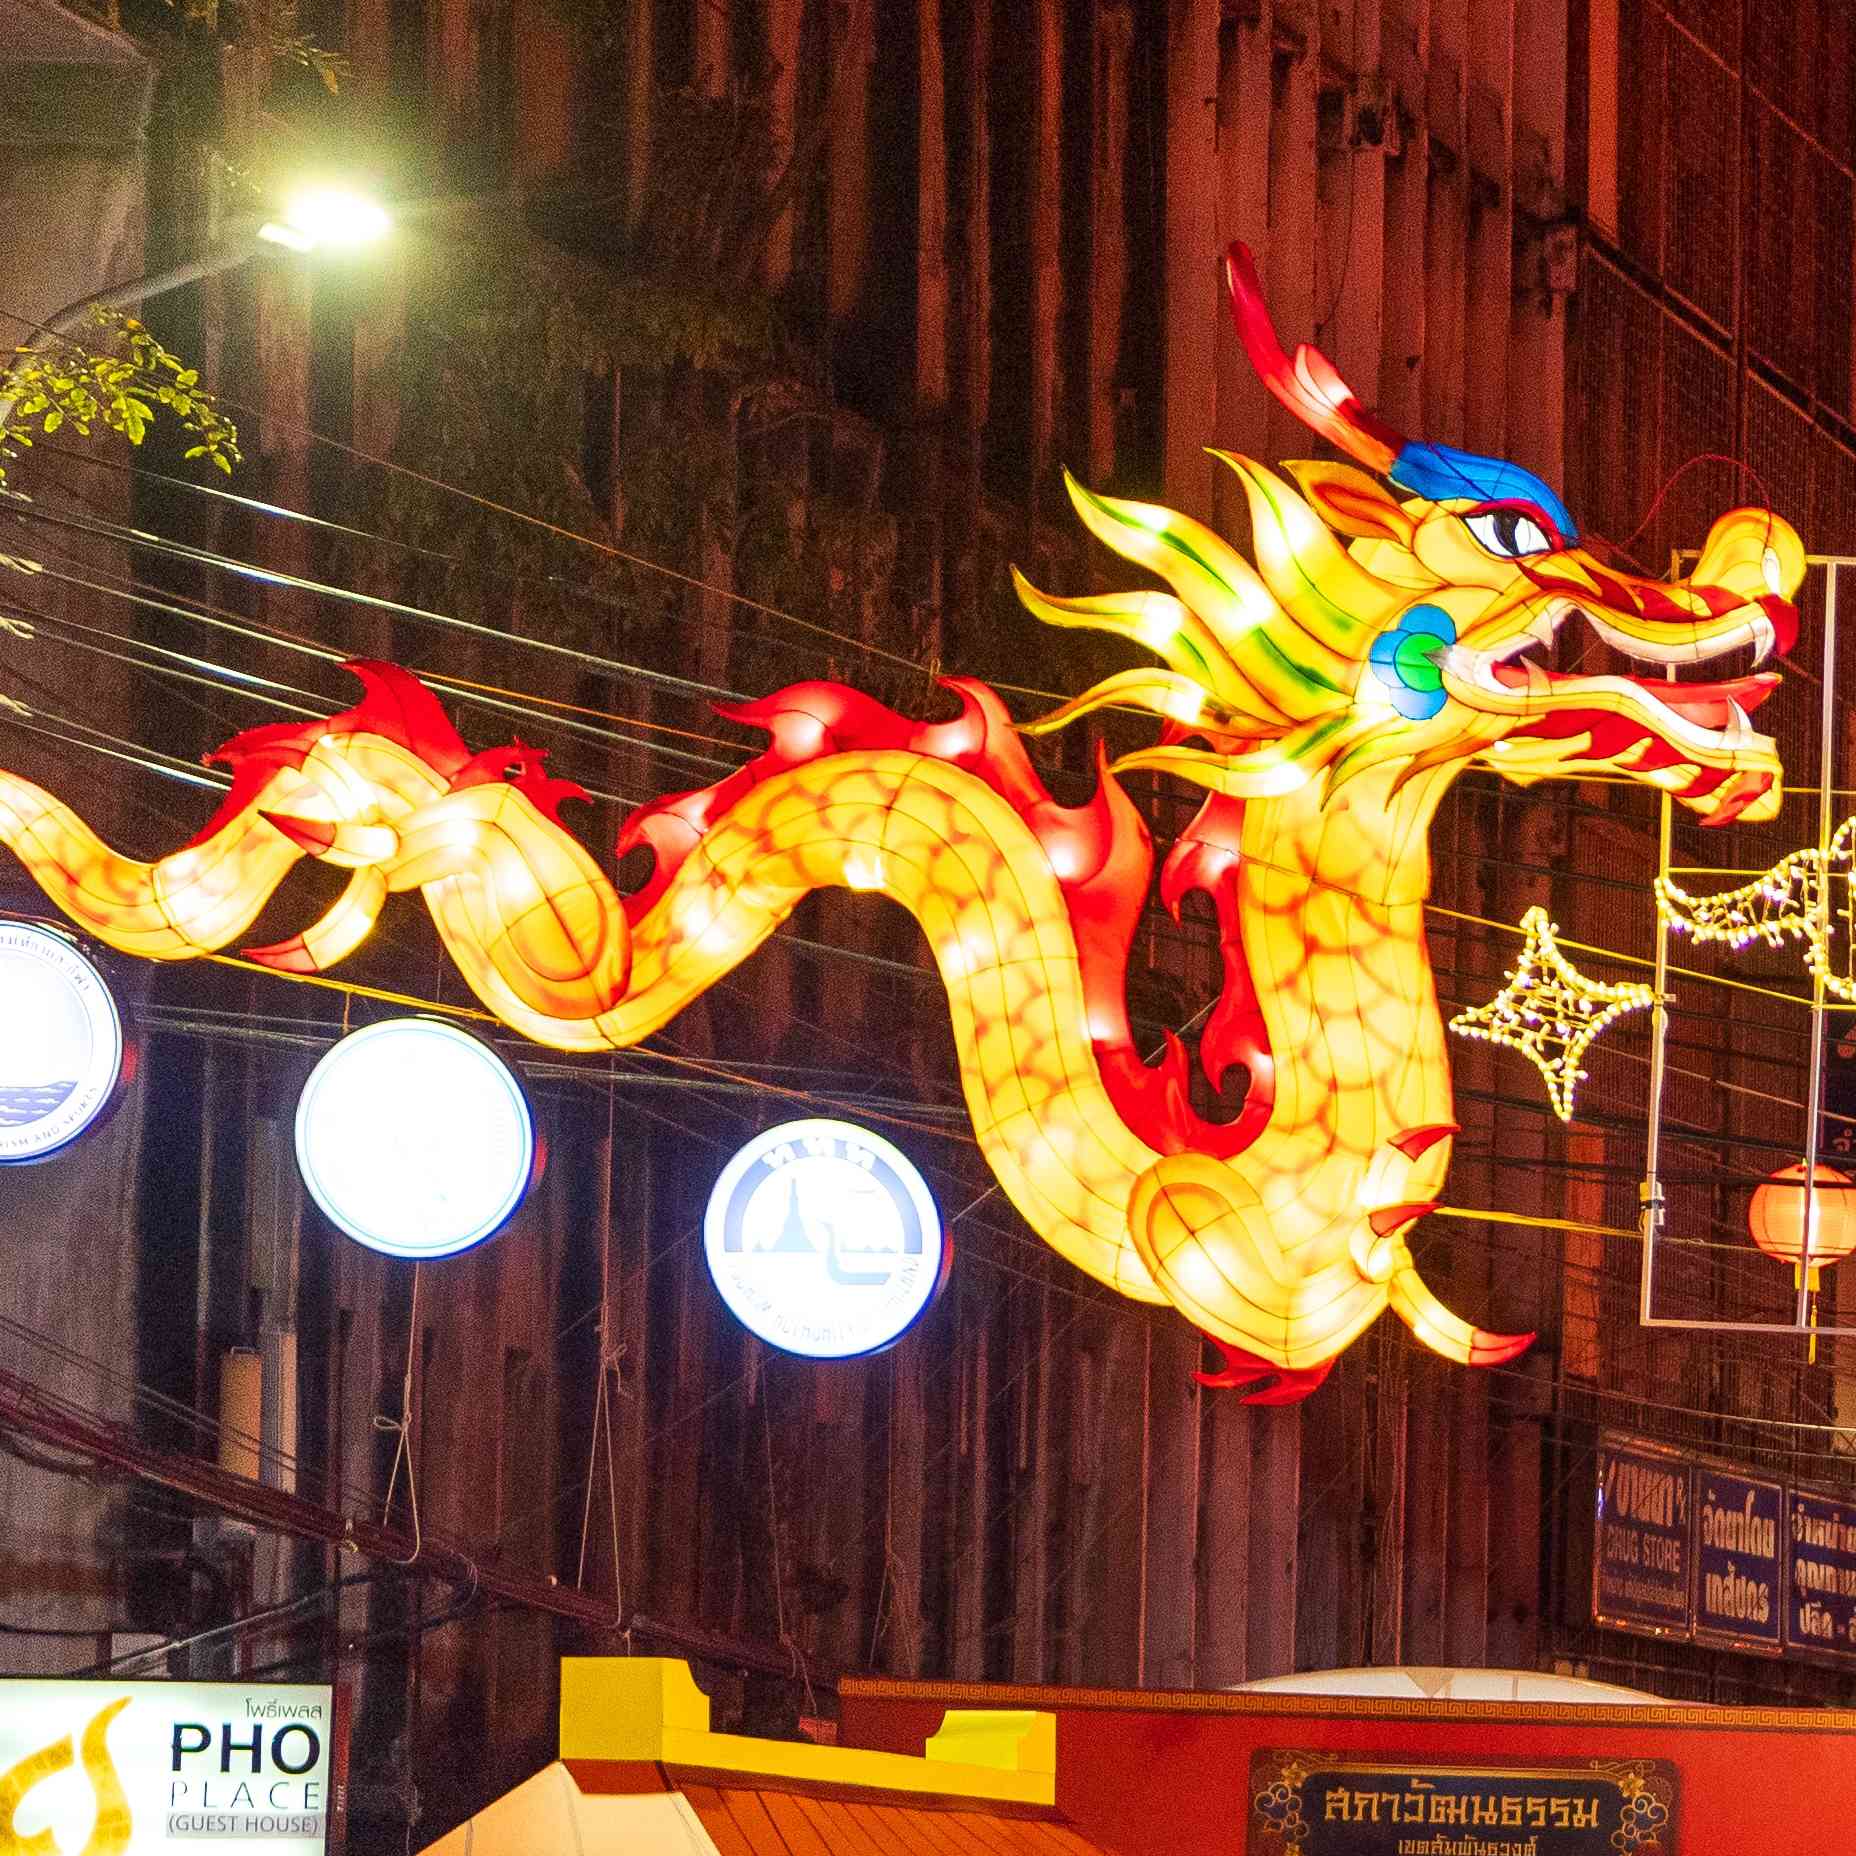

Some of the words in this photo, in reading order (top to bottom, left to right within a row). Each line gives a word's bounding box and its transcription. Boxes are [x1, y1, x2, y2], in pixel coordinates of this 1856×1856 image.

[1644, 1531, 1681, 1574] STORE
[171, 1722, 321, 1775] PHO
[169, 1779, 321, 1811] PLACE
[1323, 1778, 1600, 1830] สภาวัฒนธรรม
[167, 1813, 243, 1835] (GUEST
[245, 1814, 320, 1835] HOUSE)
